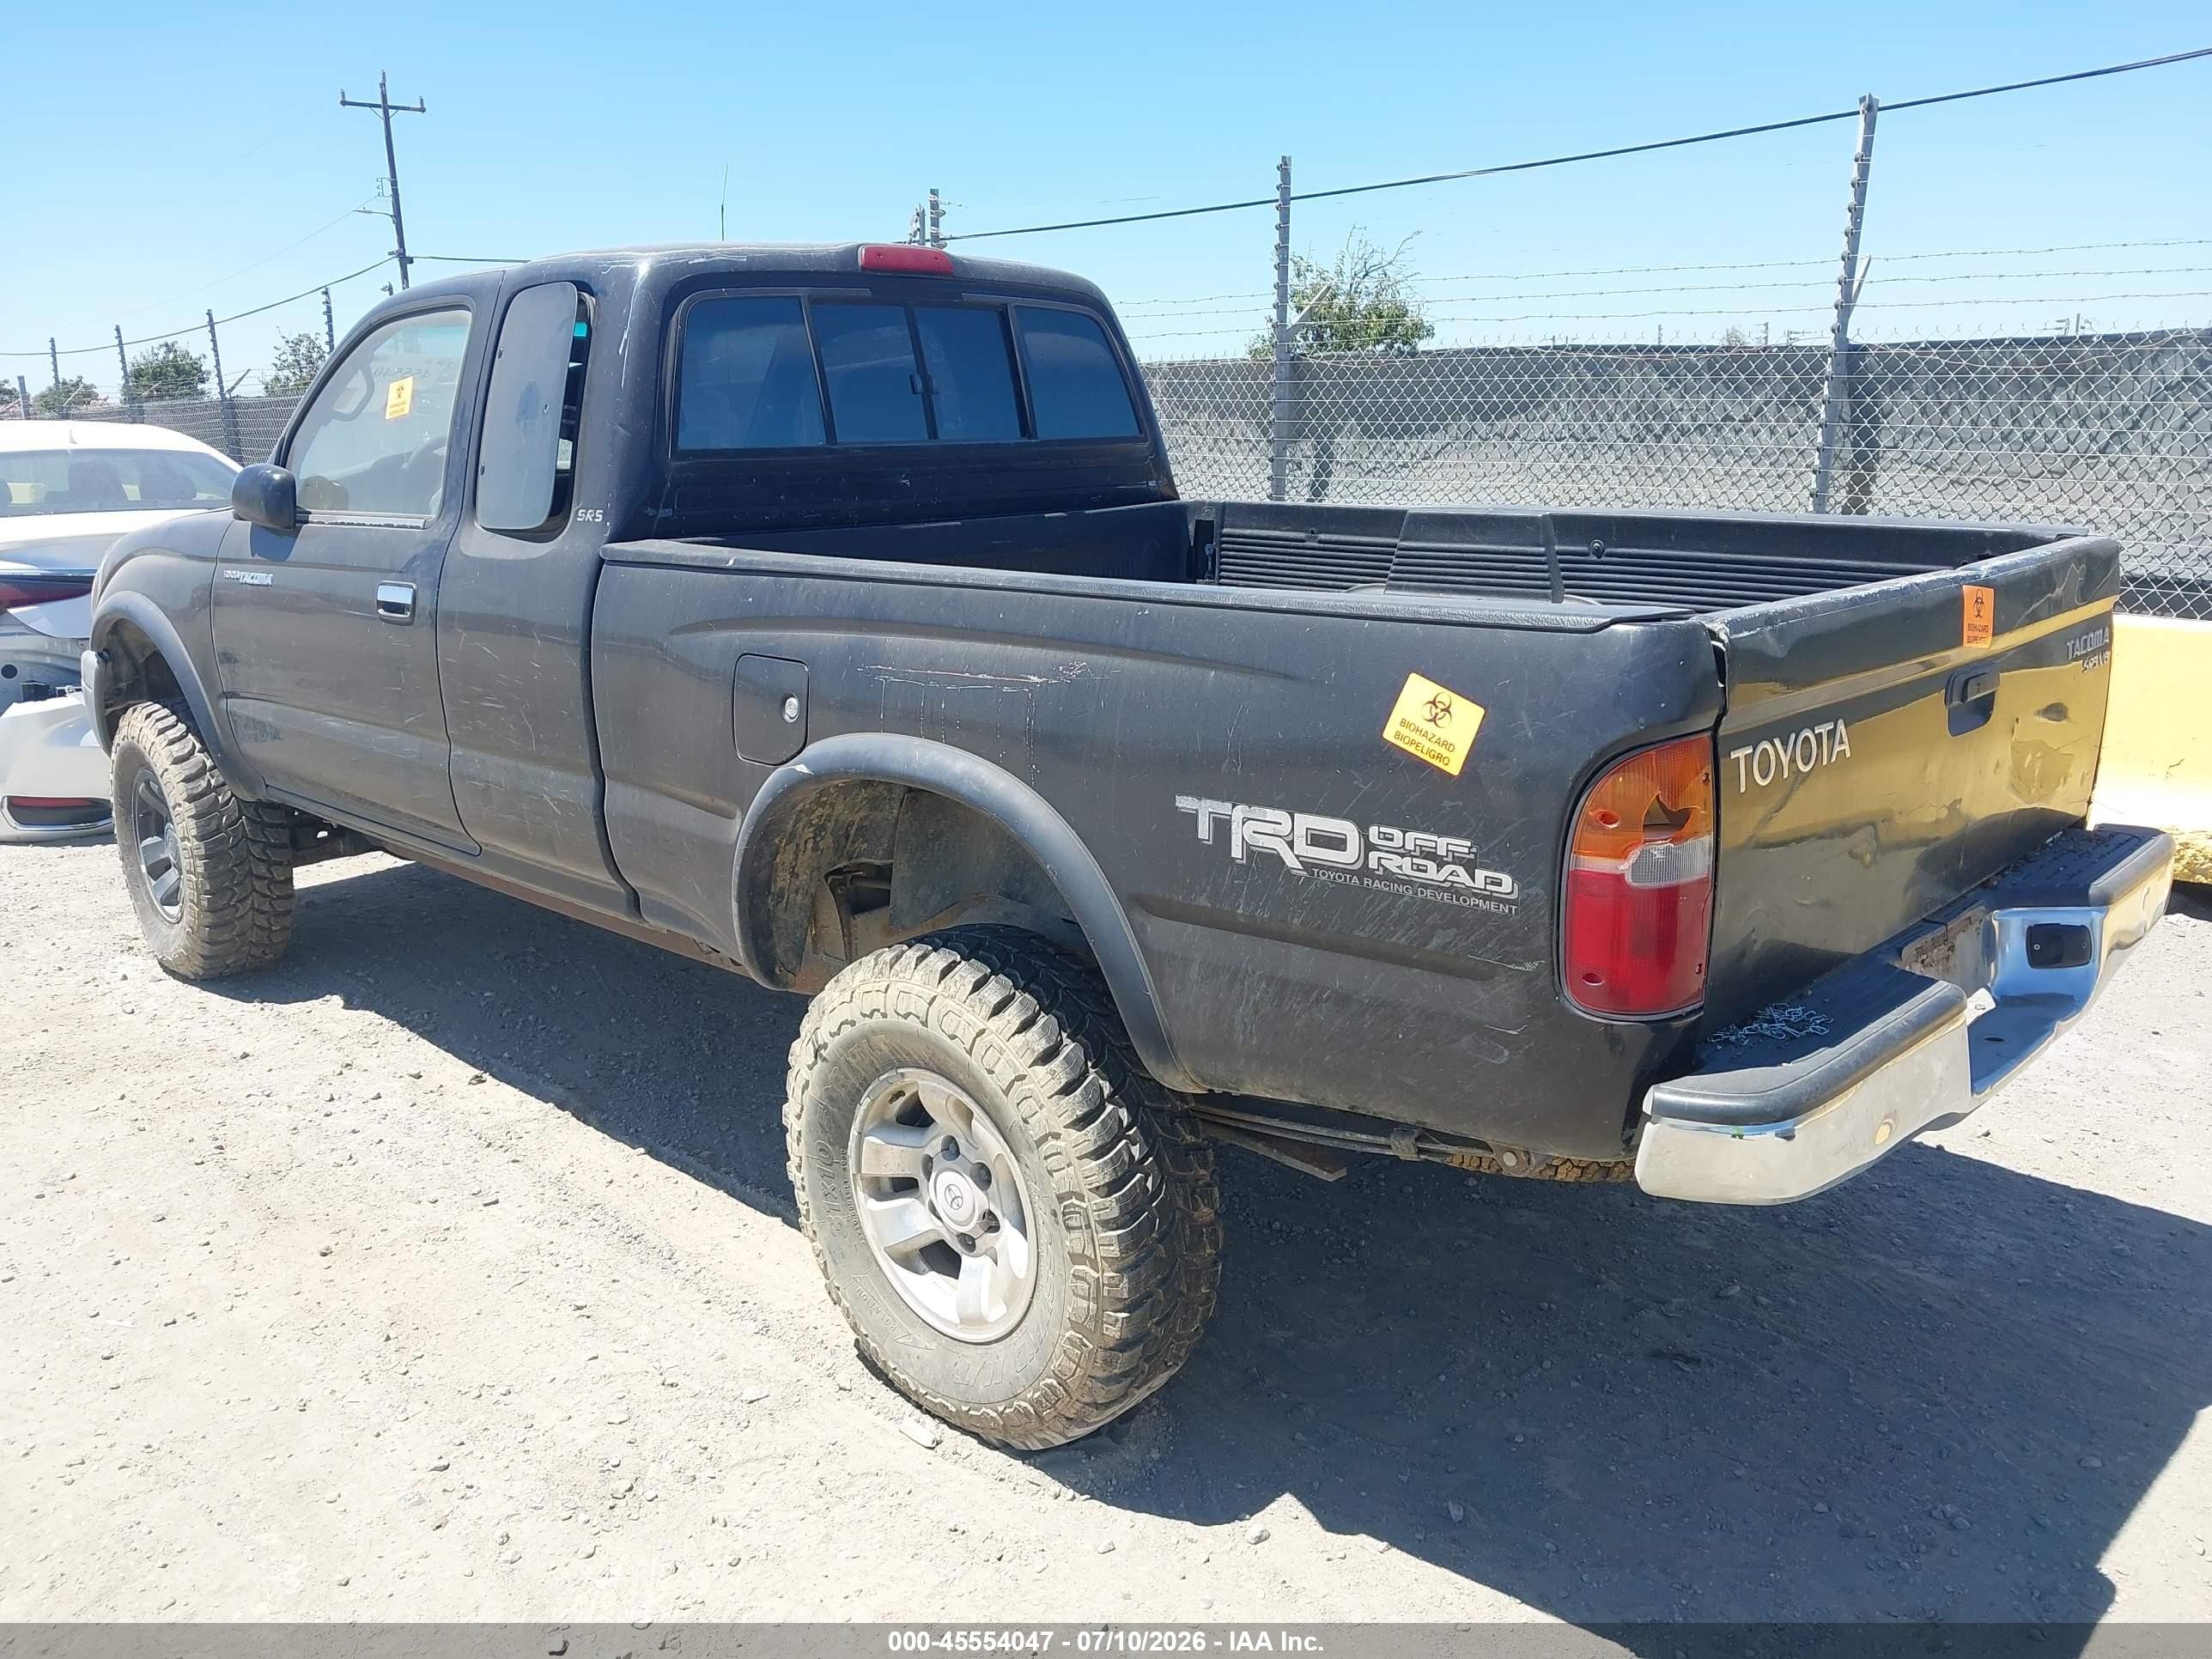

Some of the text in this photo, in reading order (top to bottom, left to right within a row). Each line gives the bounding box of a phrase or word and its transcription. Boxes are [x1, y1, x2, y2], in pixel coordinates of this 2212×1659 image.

[576, 509, 604, 522] SR5
[2066, 626, 2110, 659] TACOMA
[1394, 731, 1450, 766] BIOPELIGRO
[1399, 718, 1455, 753] BIOHAZARD
[1730, 718, 1851, 793] TOYOTA
[1176, 794, 1477, 876] TRD OFF
[1311, 867, 1519, 915] TOYOTA RACING DEVELOPMENT
[1369, 851, 1519, 899] ROAD
